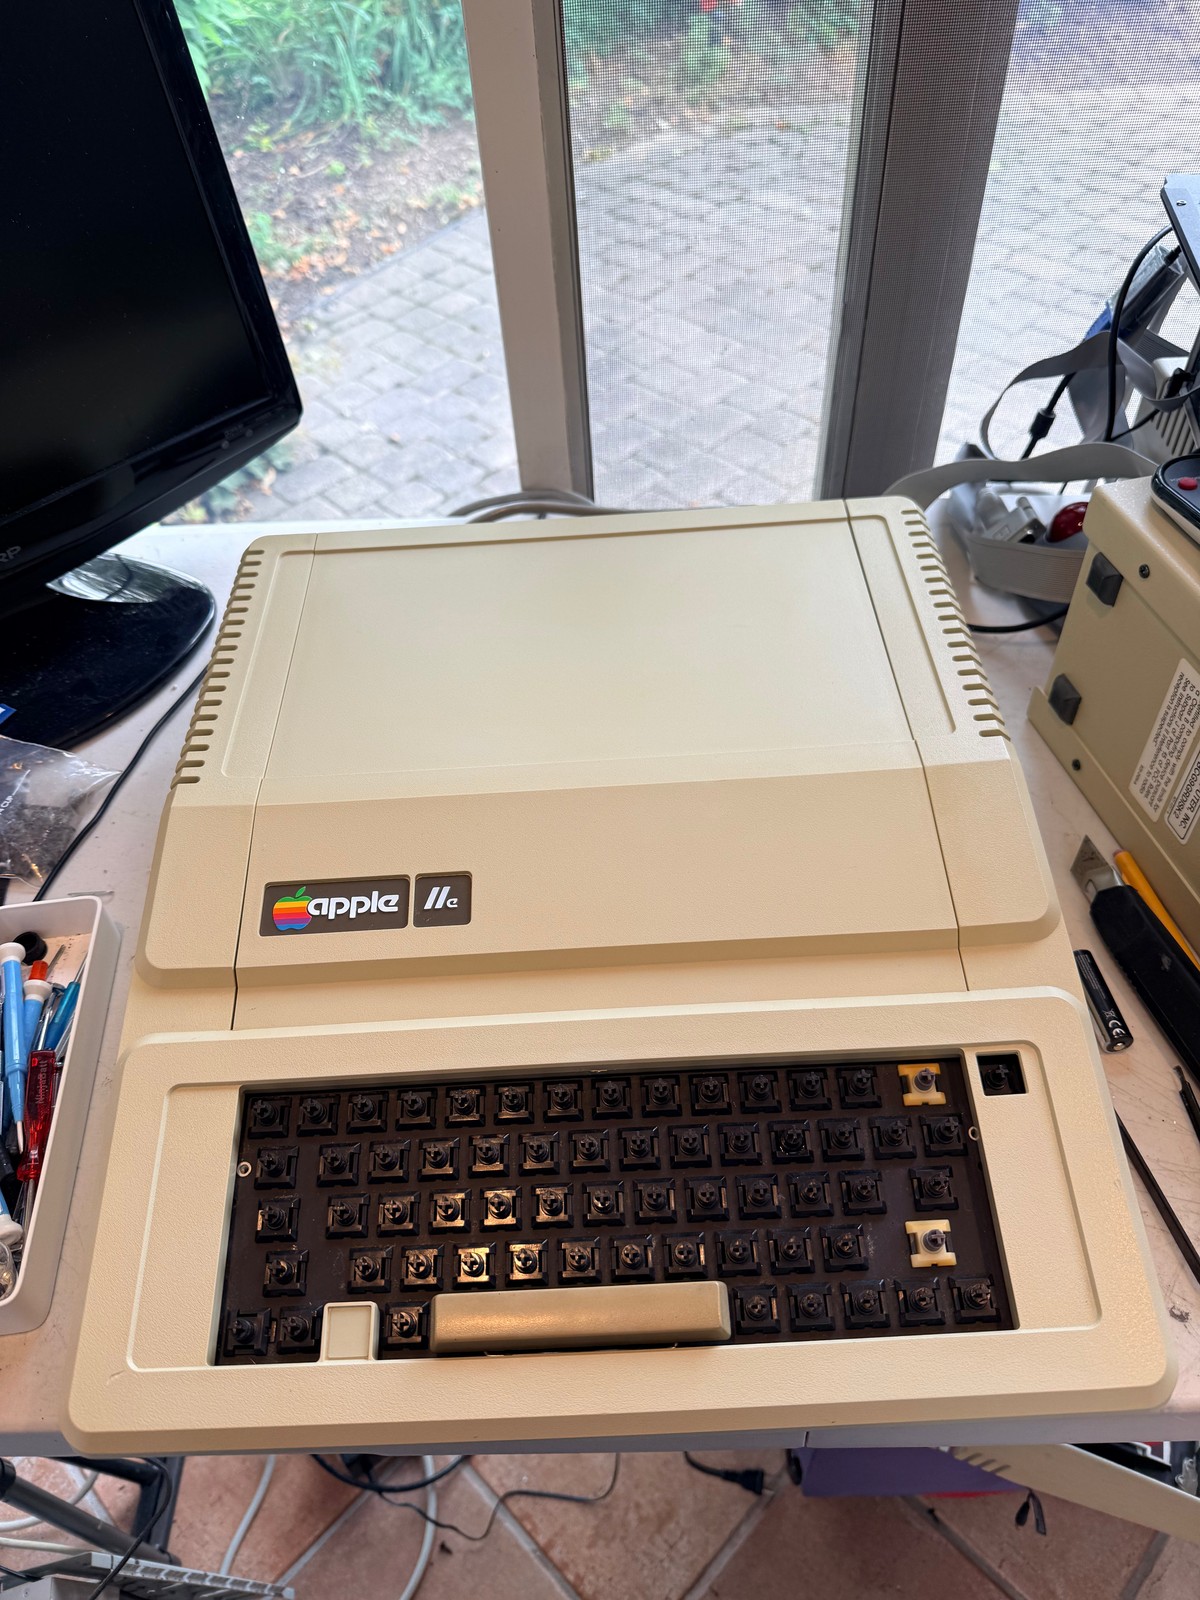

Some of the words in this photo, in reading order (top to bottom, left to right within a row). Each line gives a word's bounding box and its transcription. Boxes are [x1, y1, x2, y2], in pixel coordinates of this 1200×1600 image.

[1168, 671, 1185, 705] reception
[1181, 677, 1191, 693] See
[1166, 692, 1185, 728] instructions
[1175, 693, 1192, 722] Subpart
[1186, 697, 1198, 717] Class
[1189, 703, 1200, 730] ertified
[1149, 733, 1168, 771] interference
[1164, 735, 1174, 751] Part
[1168, 723, 1186, 759] computing
[1174, 737, 1188, 763] comply
[1151, 767, 1161, 783] FCC
[1159, 758, 1171, 781] device
[1168, 762, 1177, 776] with
[1139, 777, 1149, 794] radio
[1148, 779, 1162, 808] pursuant
[1163, 775, 1172, 788] the
[1152, 802, 1160, 813] for
[1186, 784, 1200, 813] UTER,
[1178, 812, 1191, 830] INC.
[307, 890, 400, 920] apple
